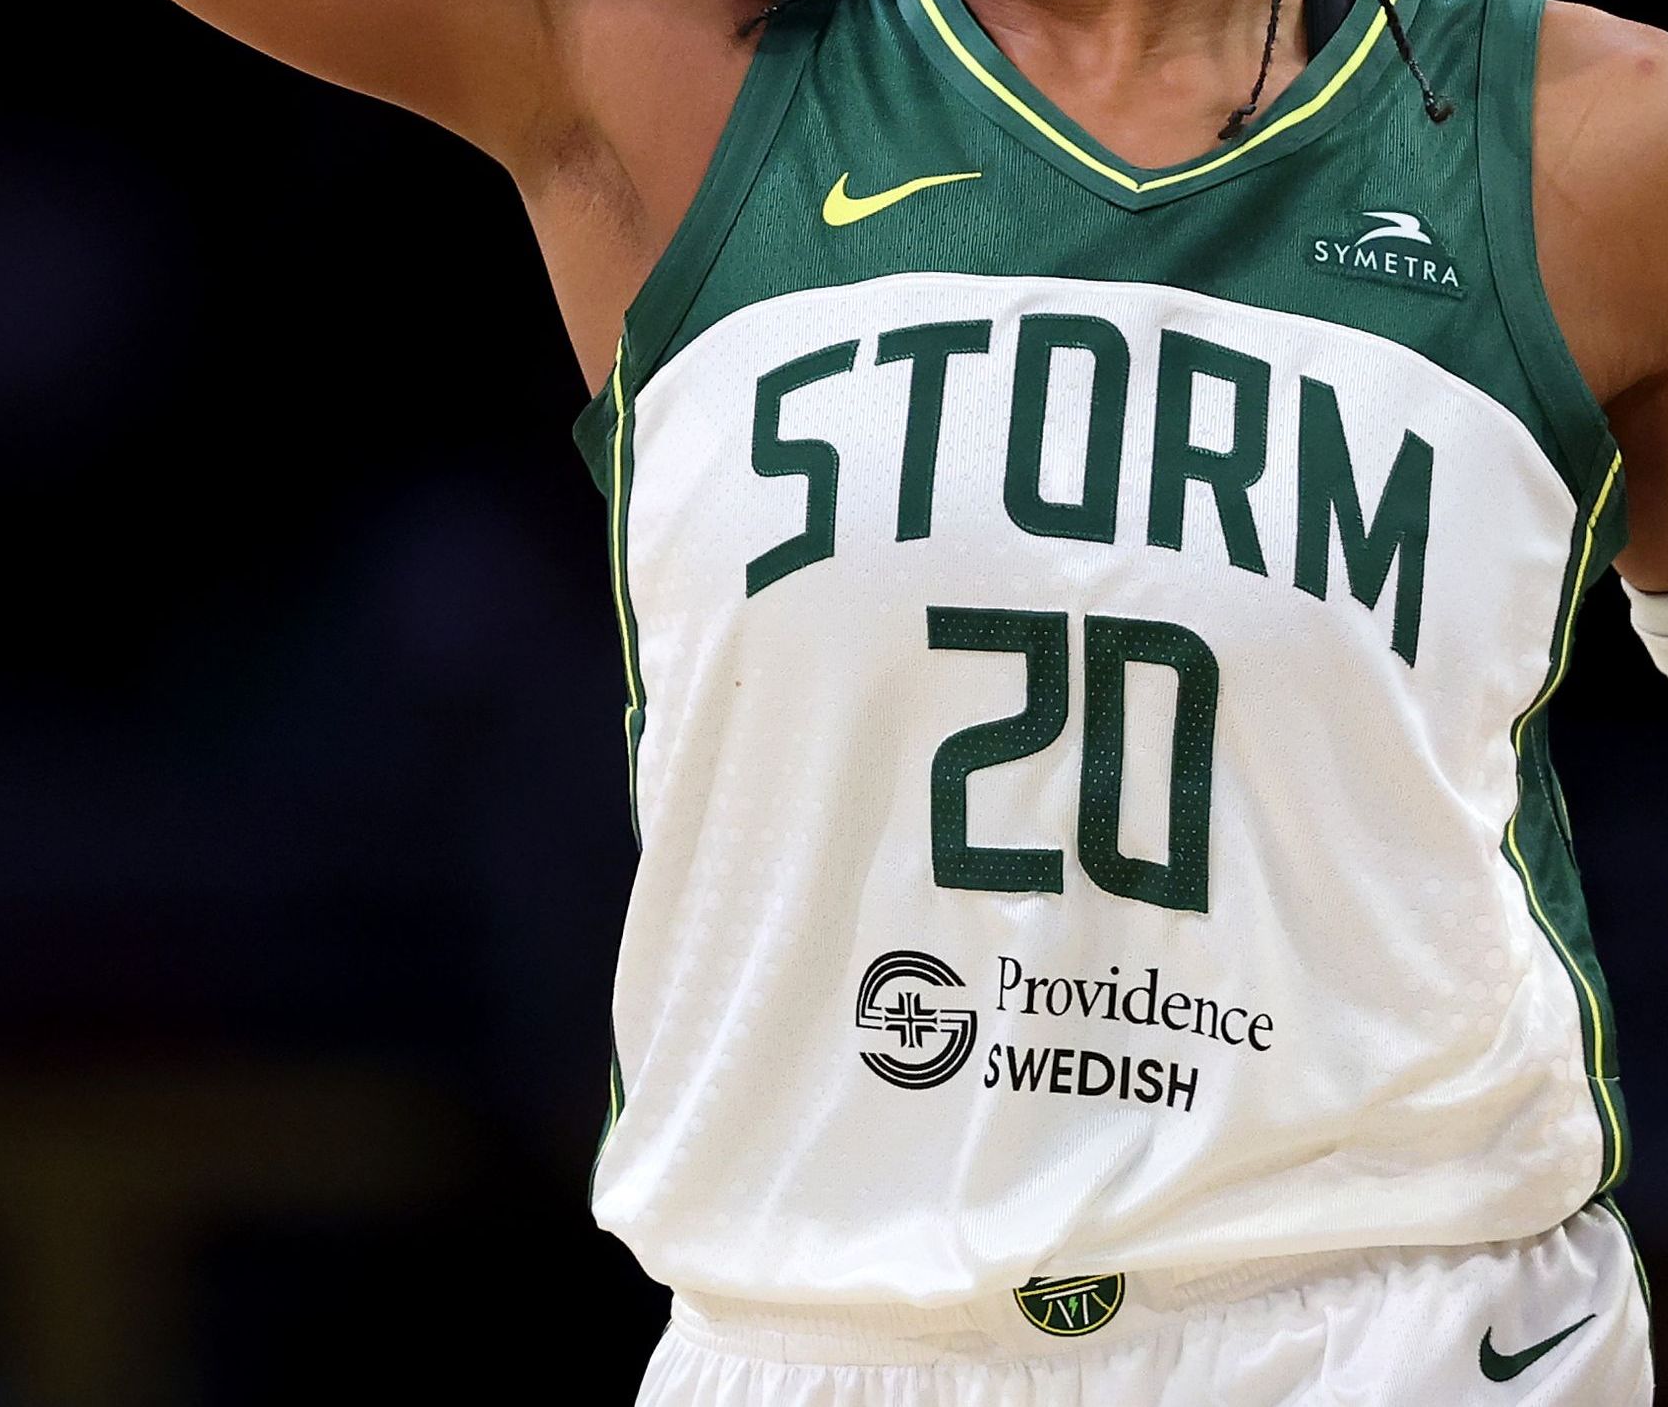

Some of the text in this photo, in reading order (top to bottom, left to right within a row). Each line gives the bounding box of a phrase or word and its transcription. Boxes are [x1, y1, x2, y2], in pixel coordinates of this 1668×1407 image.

[1314, 240, 1460, 288] SYMETRA
[746, 313, 1434, 669] STORM
[926, 604, 1220, 914] 20
[996, 955, 1274, 1052] Providence
[983, 1043, 1199, 1112] SWEDISH
